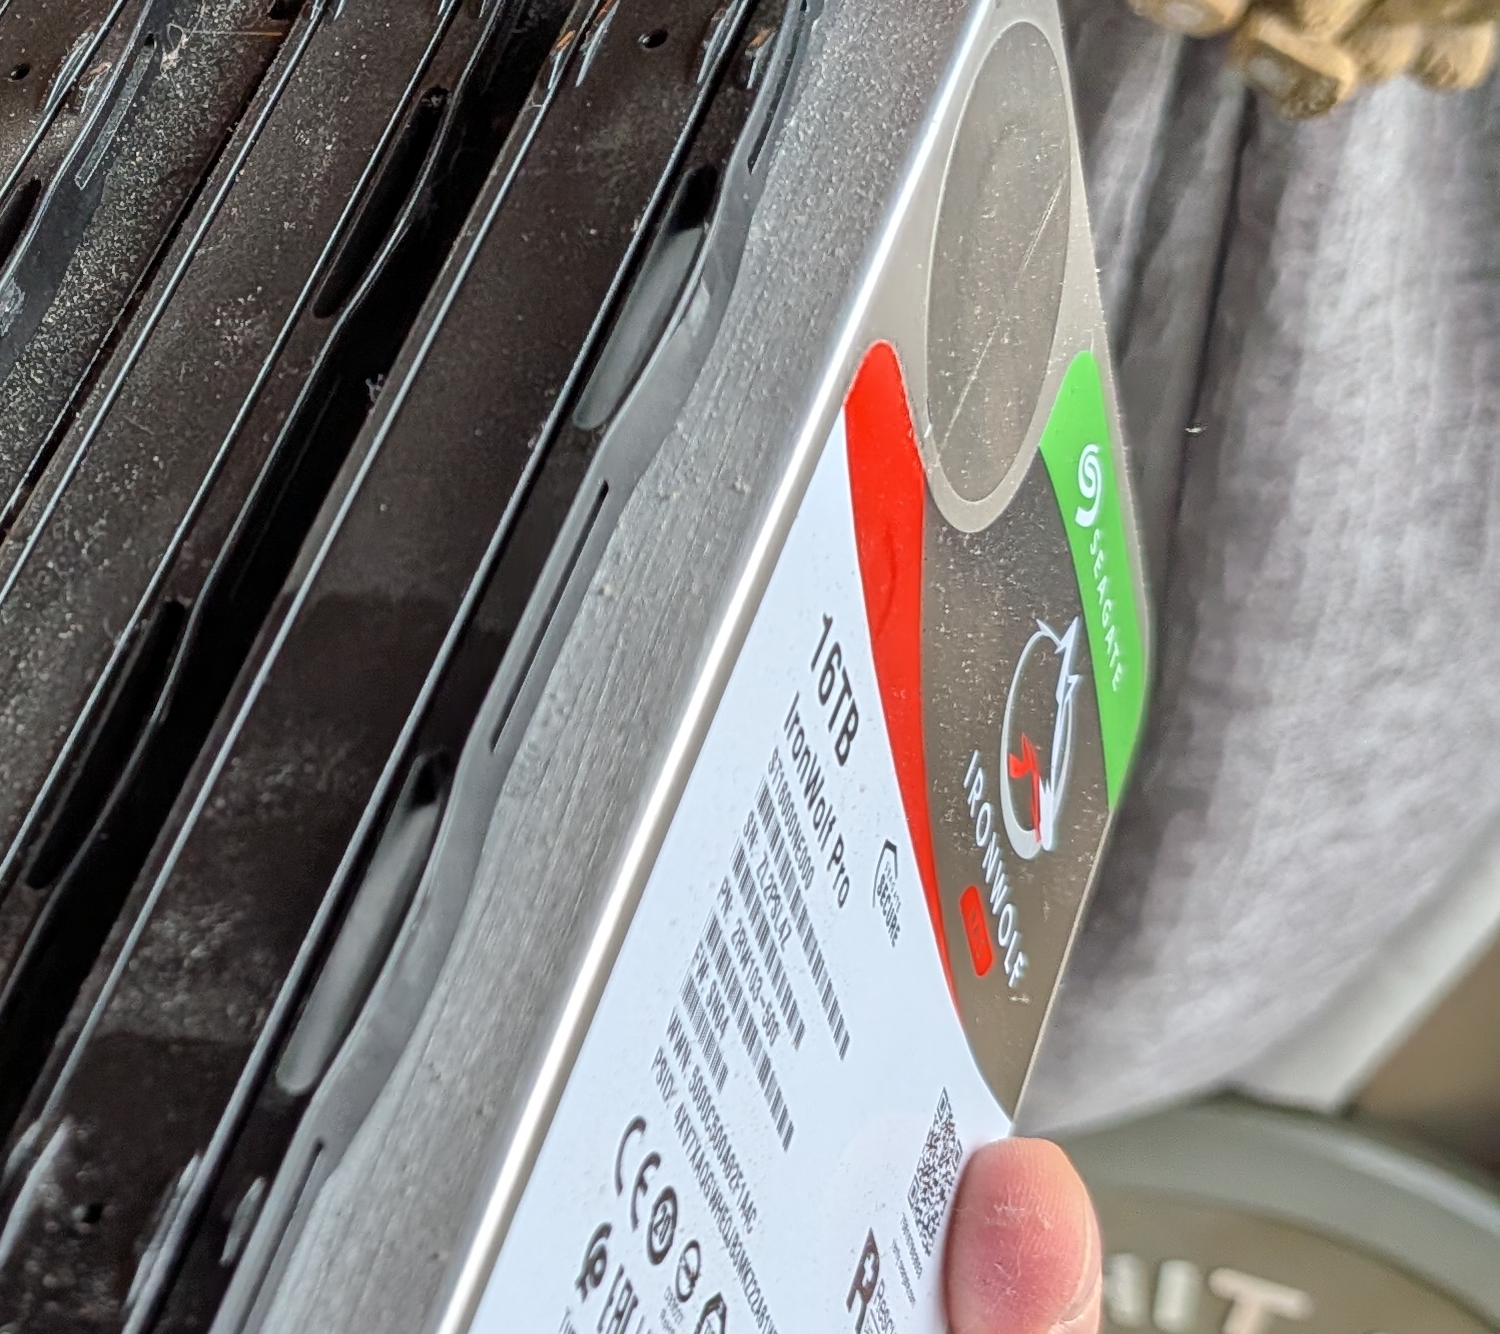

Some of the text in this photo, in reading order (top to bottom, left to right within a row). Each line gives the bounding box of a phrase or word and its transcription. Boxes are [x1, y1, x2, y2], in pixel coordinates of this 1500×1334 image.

[1088, 528, 1124, 693] SEAGATE
[810, 613, 860, 767] 16TB
[783, 691, 850, 909] IronWolf Pro
[962, 749, 1028, 988] IRONWOLF
[743, 810, 793, 953] SN: ZL2PSL4Z
[876, 873, 901, 948] SECURE
[691, 940, 730, 1041] FW: SN04
[716, 875, 780, 1047] PN: 2RW103-500
[651, 1046, 676, 1109] PSID:
[666, 1007, 692, 1079] WWN:
